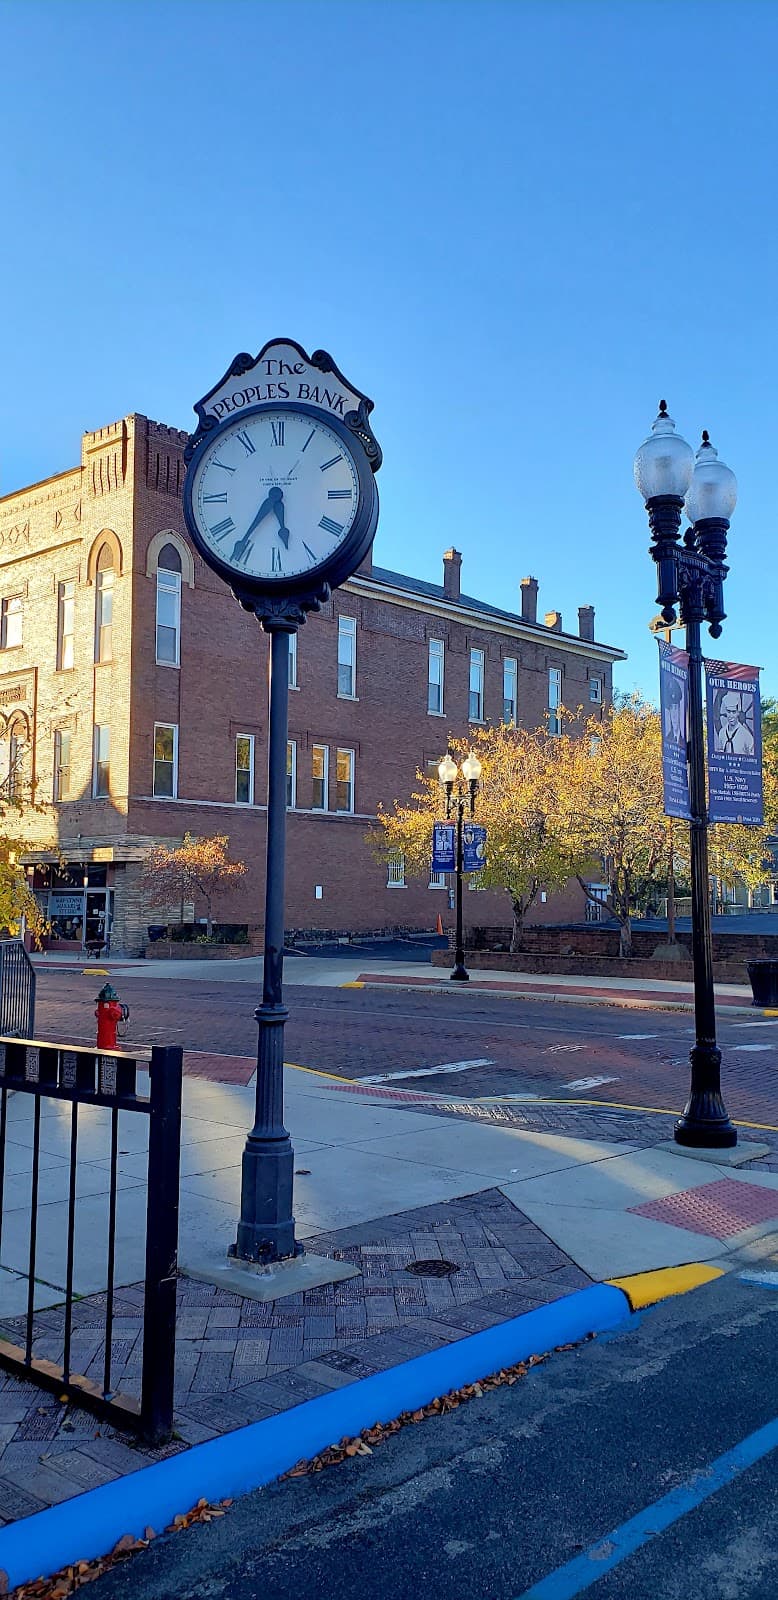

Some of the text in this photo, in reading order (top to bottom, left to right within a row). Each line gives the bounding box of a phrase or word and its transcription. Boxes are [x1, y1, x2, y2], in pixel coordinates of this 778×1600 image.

[262, 359, 307, 376] The
[210, 382, 350, 419] PEOPLES BANK
[270, 421, 285, 447] XII
[320, 454, 344, 472] II
[327, 489, 352, 500] III
[709, 677, 757, 693] OUR HEROES
